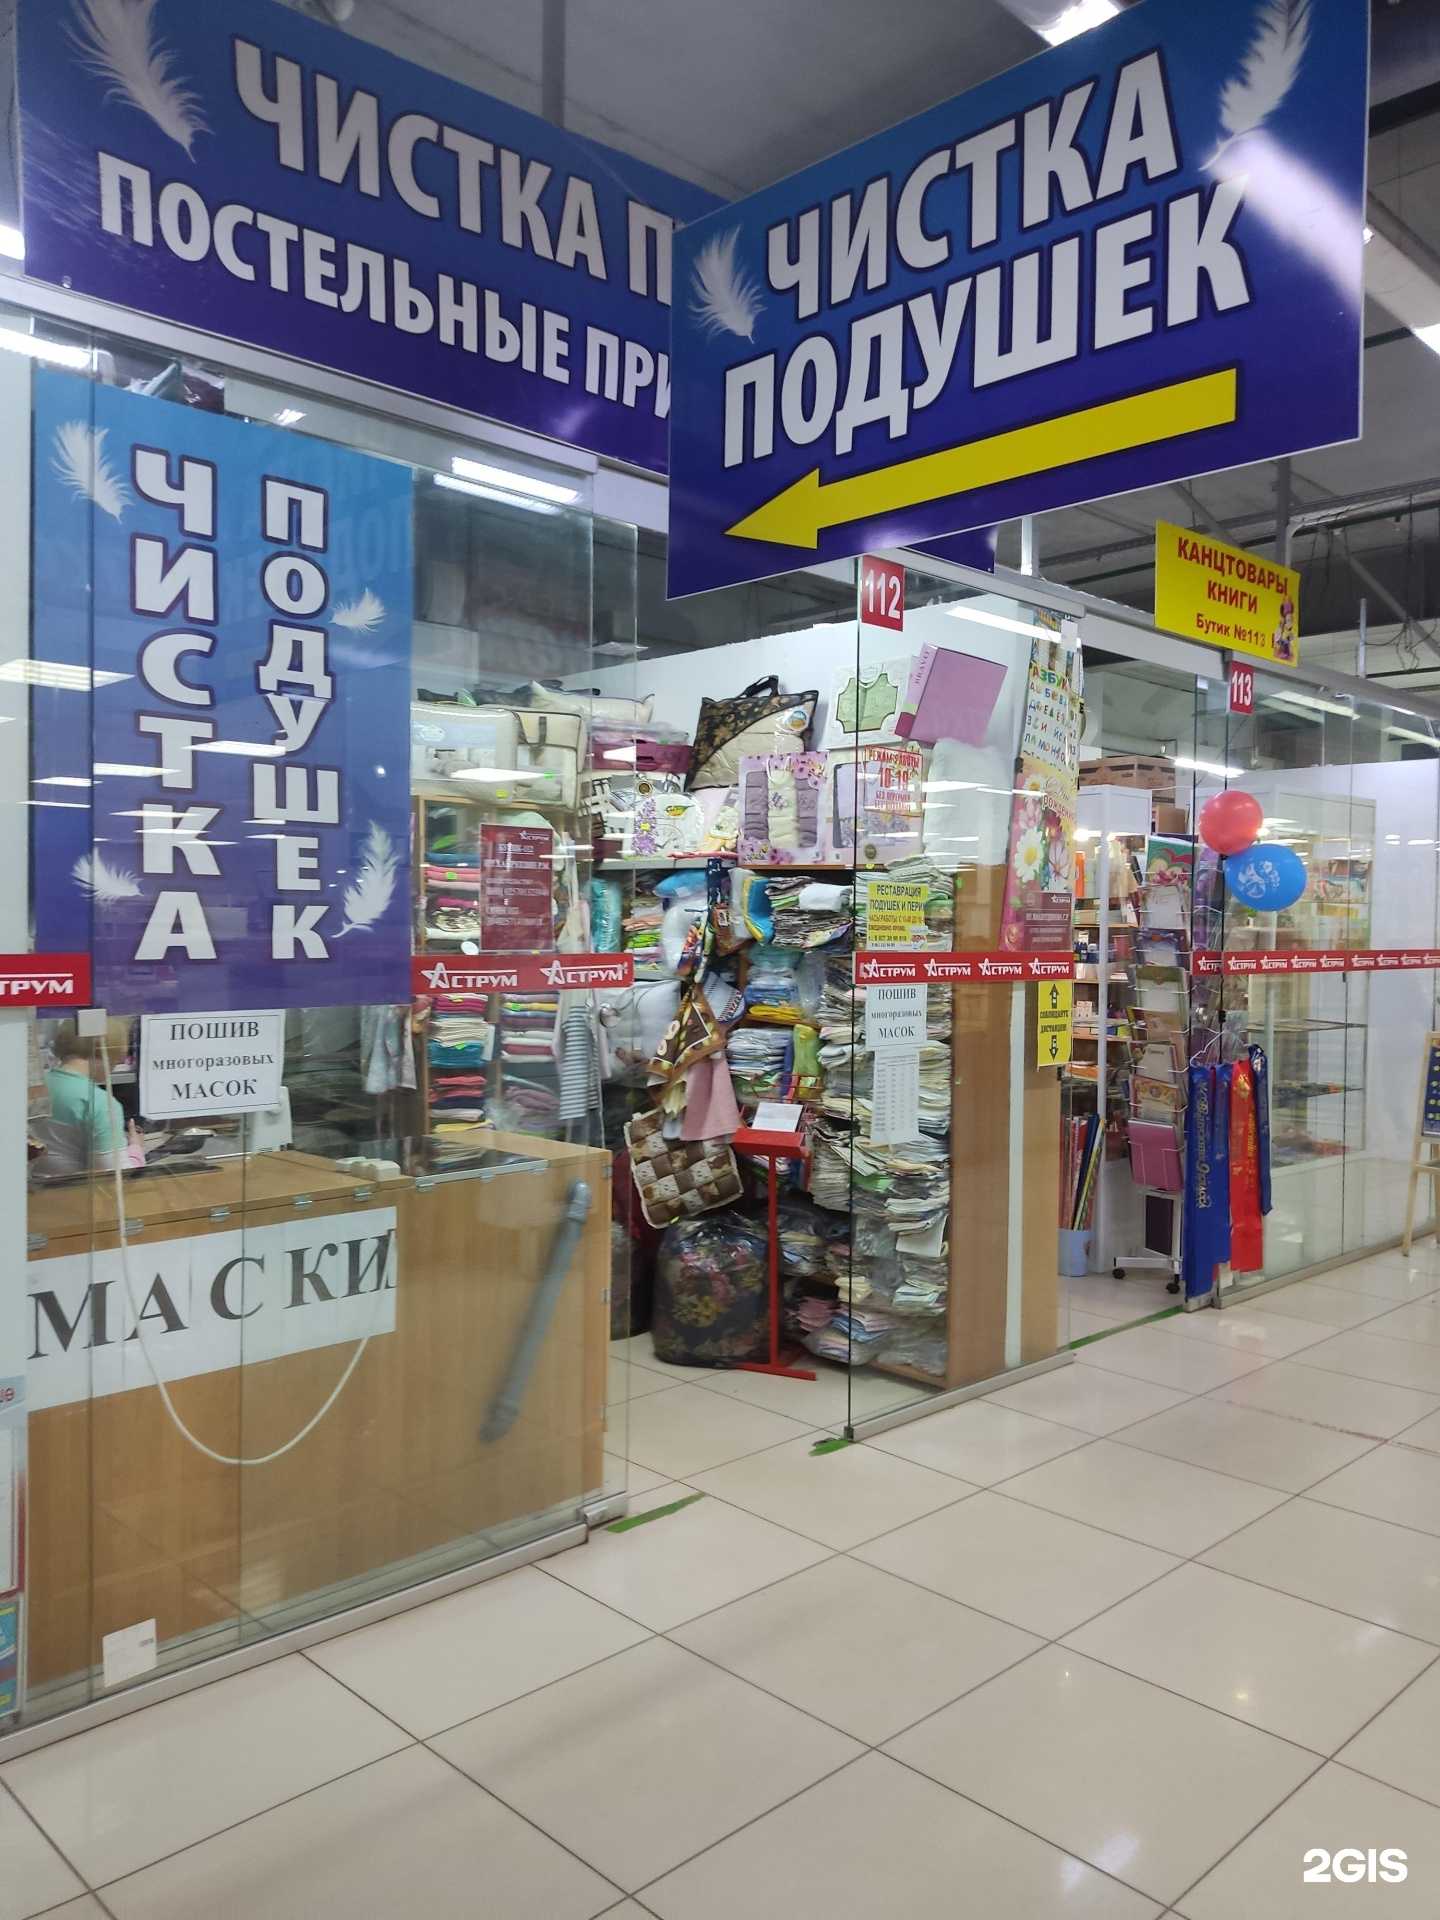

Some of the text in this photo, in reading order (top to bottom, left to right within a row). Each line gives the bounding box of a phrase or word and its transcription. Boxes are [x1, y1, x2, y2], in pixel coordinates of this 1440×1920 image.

[234, 38, 608, 280] ЧИСТКА
[766, 50, 1178, 319] ЧИСТКА
[98, 151, 571, 384] ПОСТЕЛЬНЫЕ
[724, 173, 1250, 467] ПОДУШЕК
[1178, 537, 1288, 595] КАНЦТОВАРЫ
[865, 569, 901, 619] 112
[1207, 580, 1258, 614] КНИГИ
[1196, 613, 1231, 635] Бутик
[134, 449, 221, 961] ЧИСТКА
[1232, 671, 1252, 706] 113
[253, 479, 339, 960] ПОДУШЕК
[870, 899, 900, 911] ПОДУШЕК
[877, 884, 922, 897] РЕСТАВРАЦИЯ
[420, 959, 624, 988] АСТРУМ АСТРУМ
[864, 957, 1070, 977] АСТРУМ АСТРУМ АСТРУМ АСТРУМ
[878, 988, 916, 1000] ПОШИВ
[171, 1022, 260, 1040] ПОШИВ
[879, 1026, 915, 1038] МАСОК
[152, 1054, 275, 1071] многоразовых
[171, 1078, 257, 1100] МАСОК
[27, 1229, 397, 1360] МАСКИ
